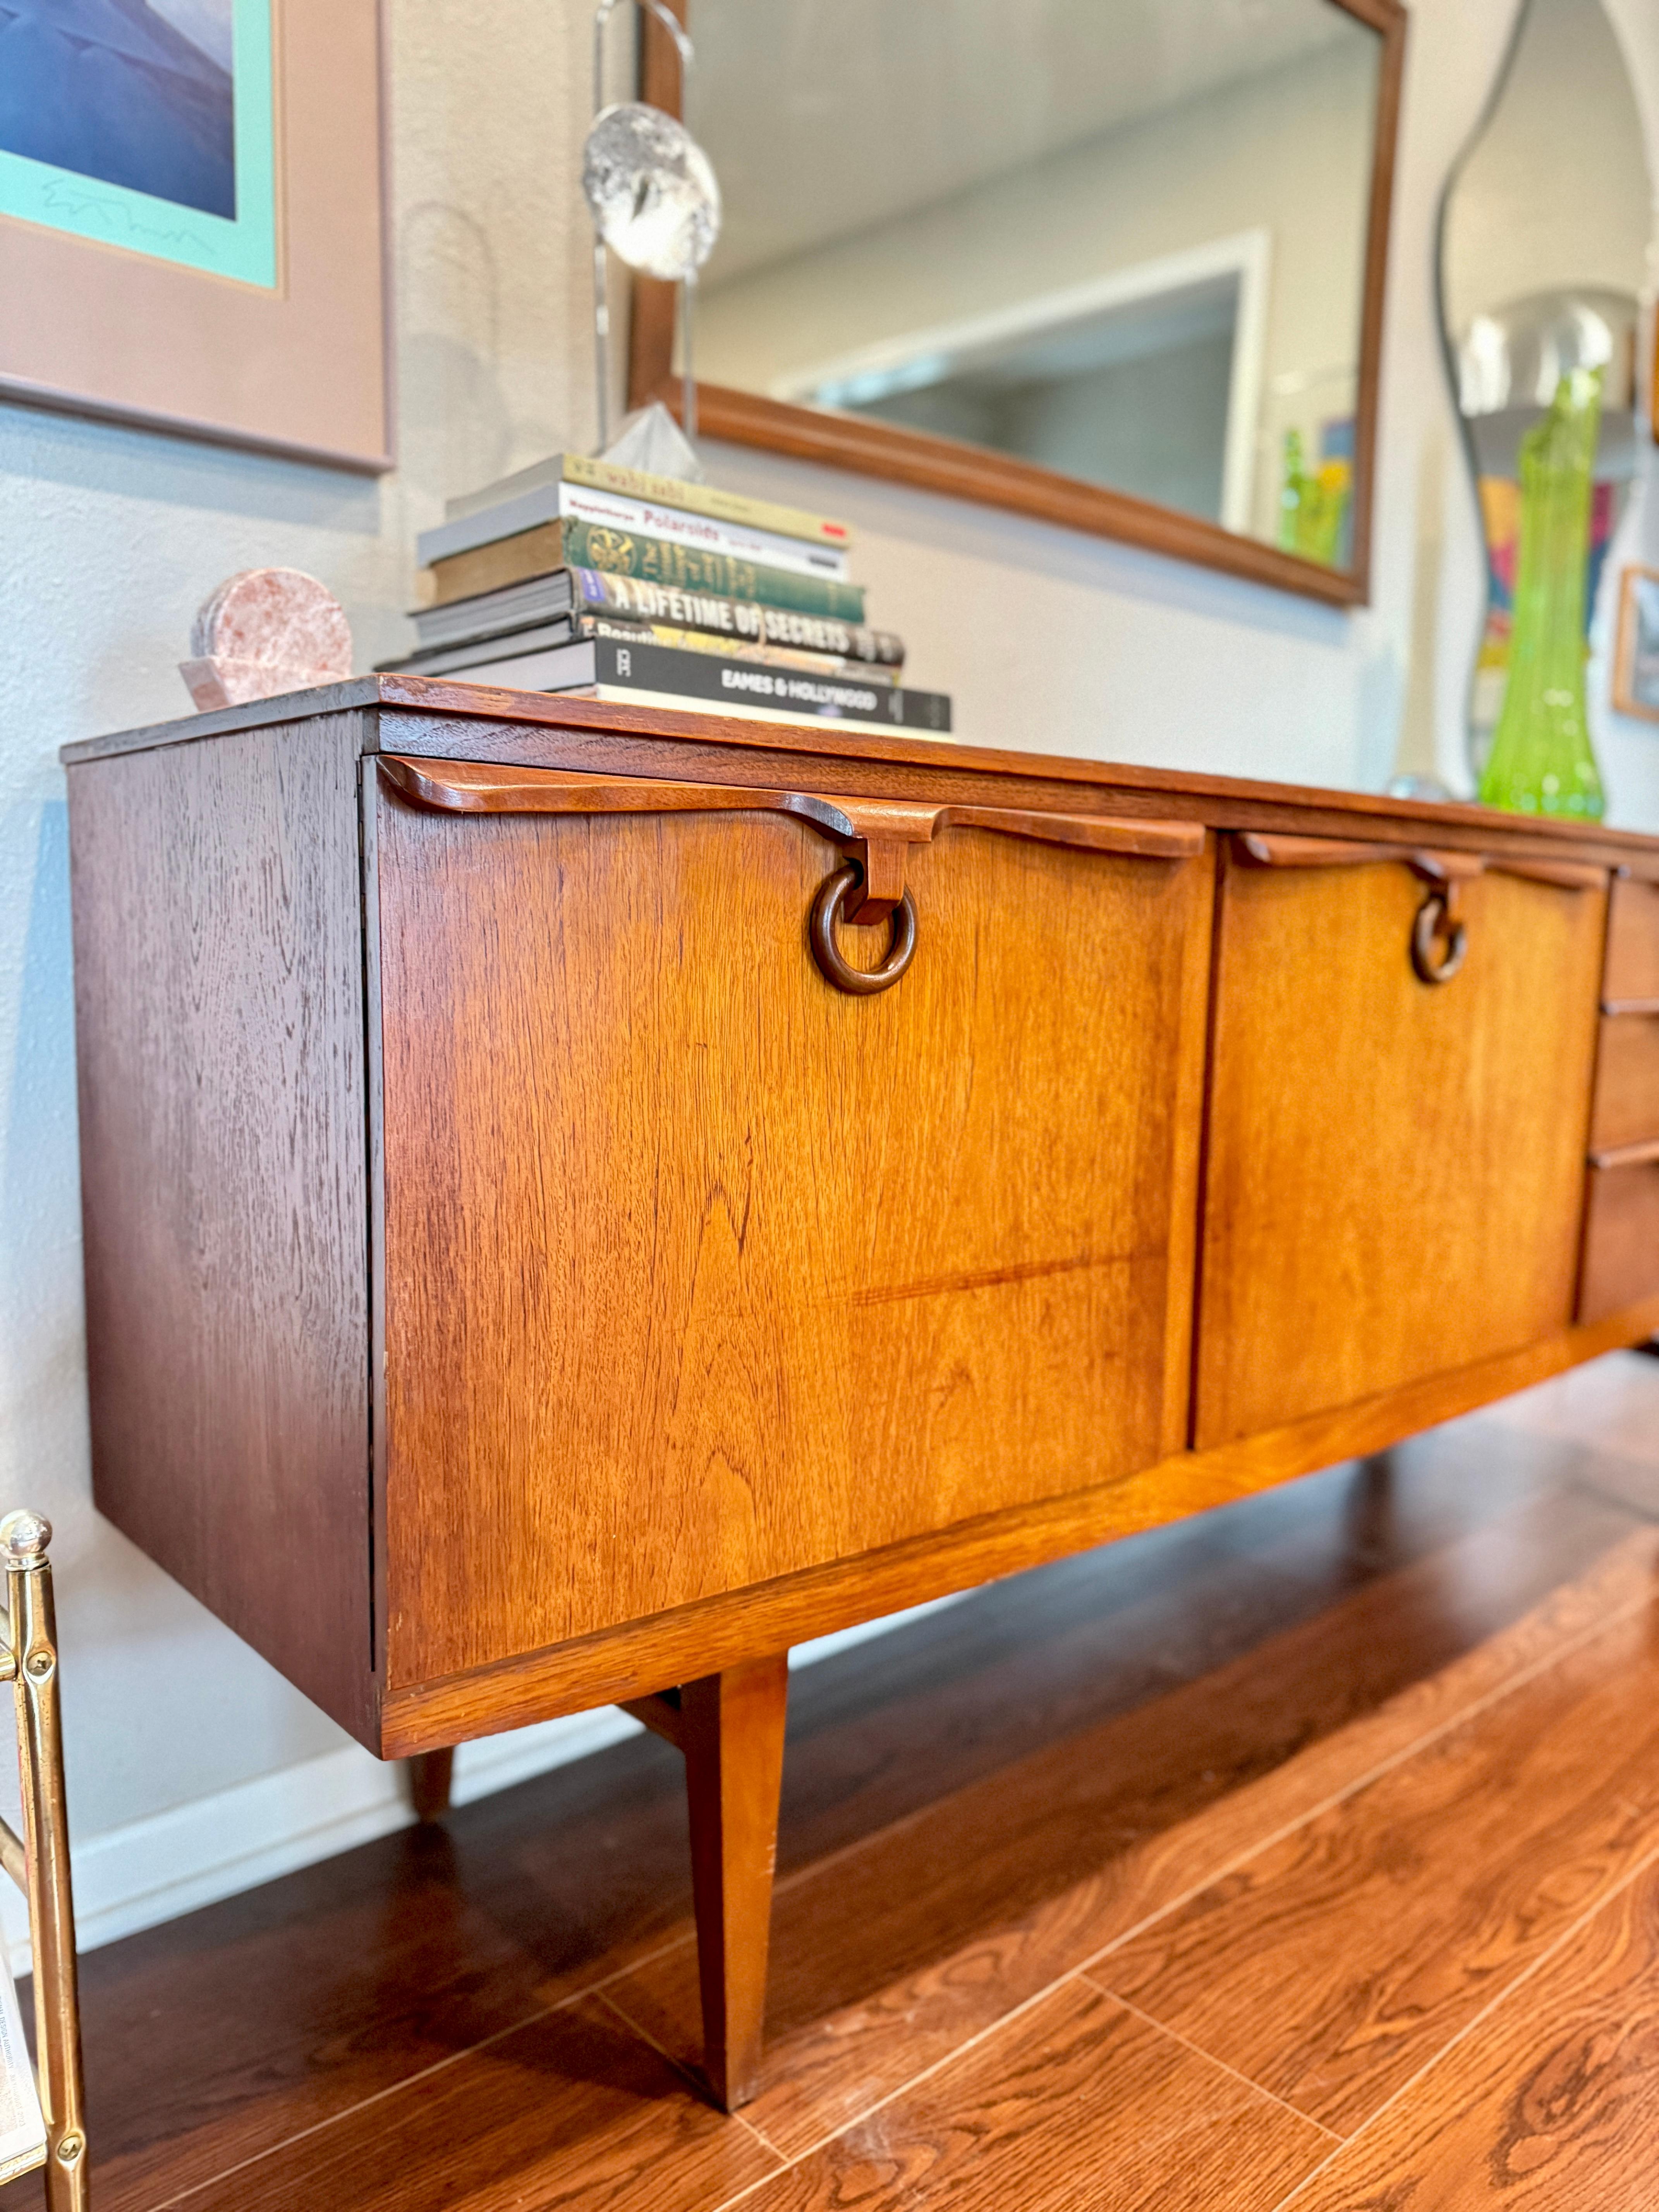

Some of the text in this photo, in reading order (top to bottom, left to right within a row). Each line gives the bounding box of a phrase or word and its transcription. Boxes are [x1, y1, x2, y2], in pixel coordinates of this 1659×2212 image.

[644, 510, 719, 541] Polaroids
[615, 581, 630, 610] A
[636, 587, 733, 630] LIFETIME
[734, 603, 760, 636] OF
[764, 610, 850, 653] SECRETS
[721, 669, 773, 695] EAMES
[774, 677, 788, 697] &
[789, 679, 878, 711] HOLLYWOOD
[3, 2039, 14, 2069] AUTHORITY
